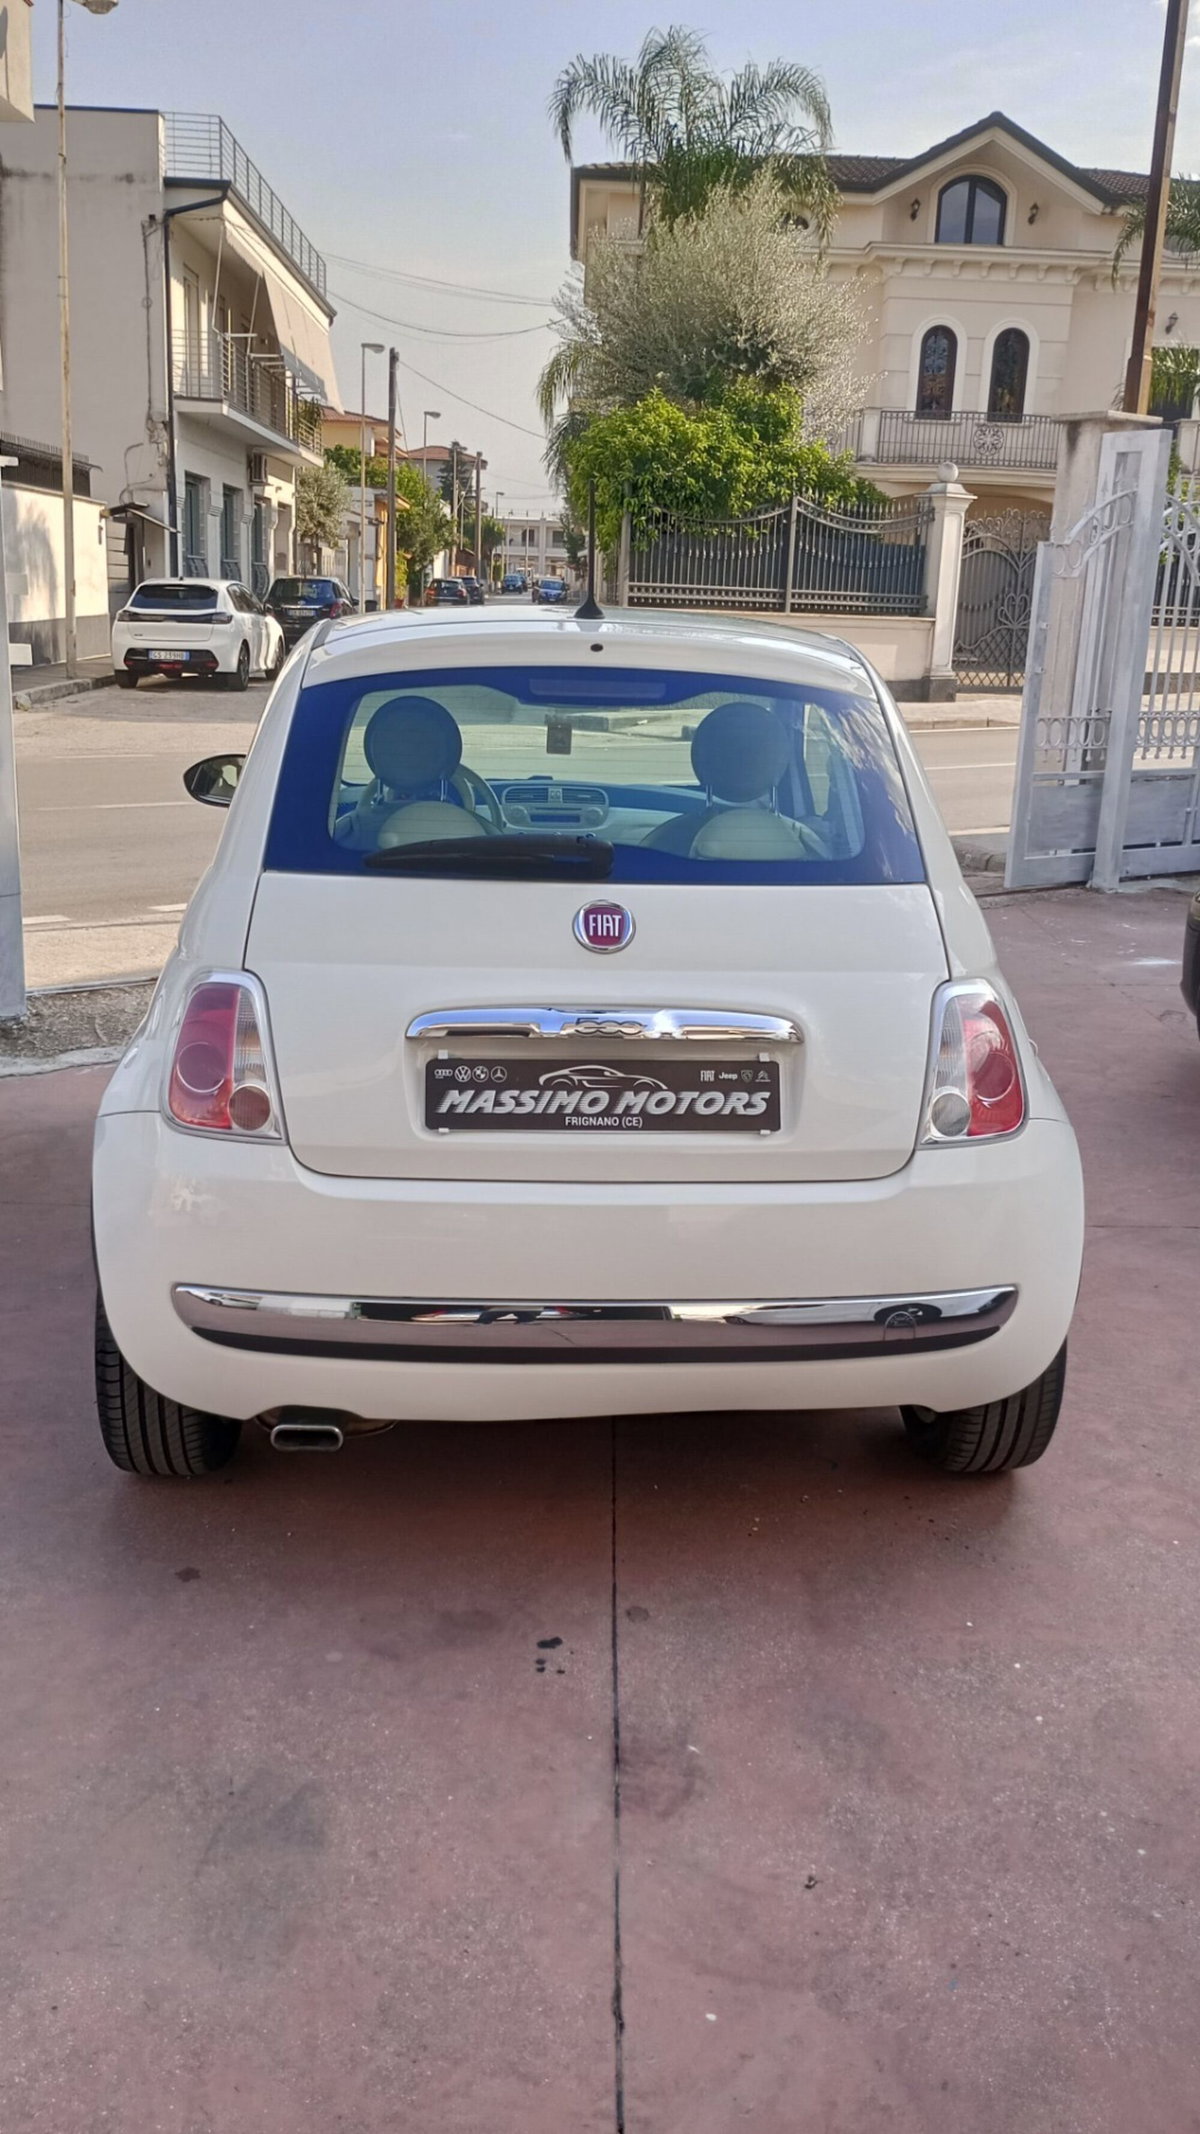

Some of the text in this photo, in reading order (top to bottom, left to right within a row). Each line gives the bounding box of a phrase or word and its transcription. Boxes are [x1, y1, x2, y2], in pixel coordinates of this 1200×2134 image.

[588, 914, 622, 937] FIAT
[700, 1070, 738, 1082] FIAT Jeep
[437, 1090, 770, 1115] MASSIMO MOTORS
[565, 1116, 643, 1129] FRIGNANO (CE)
